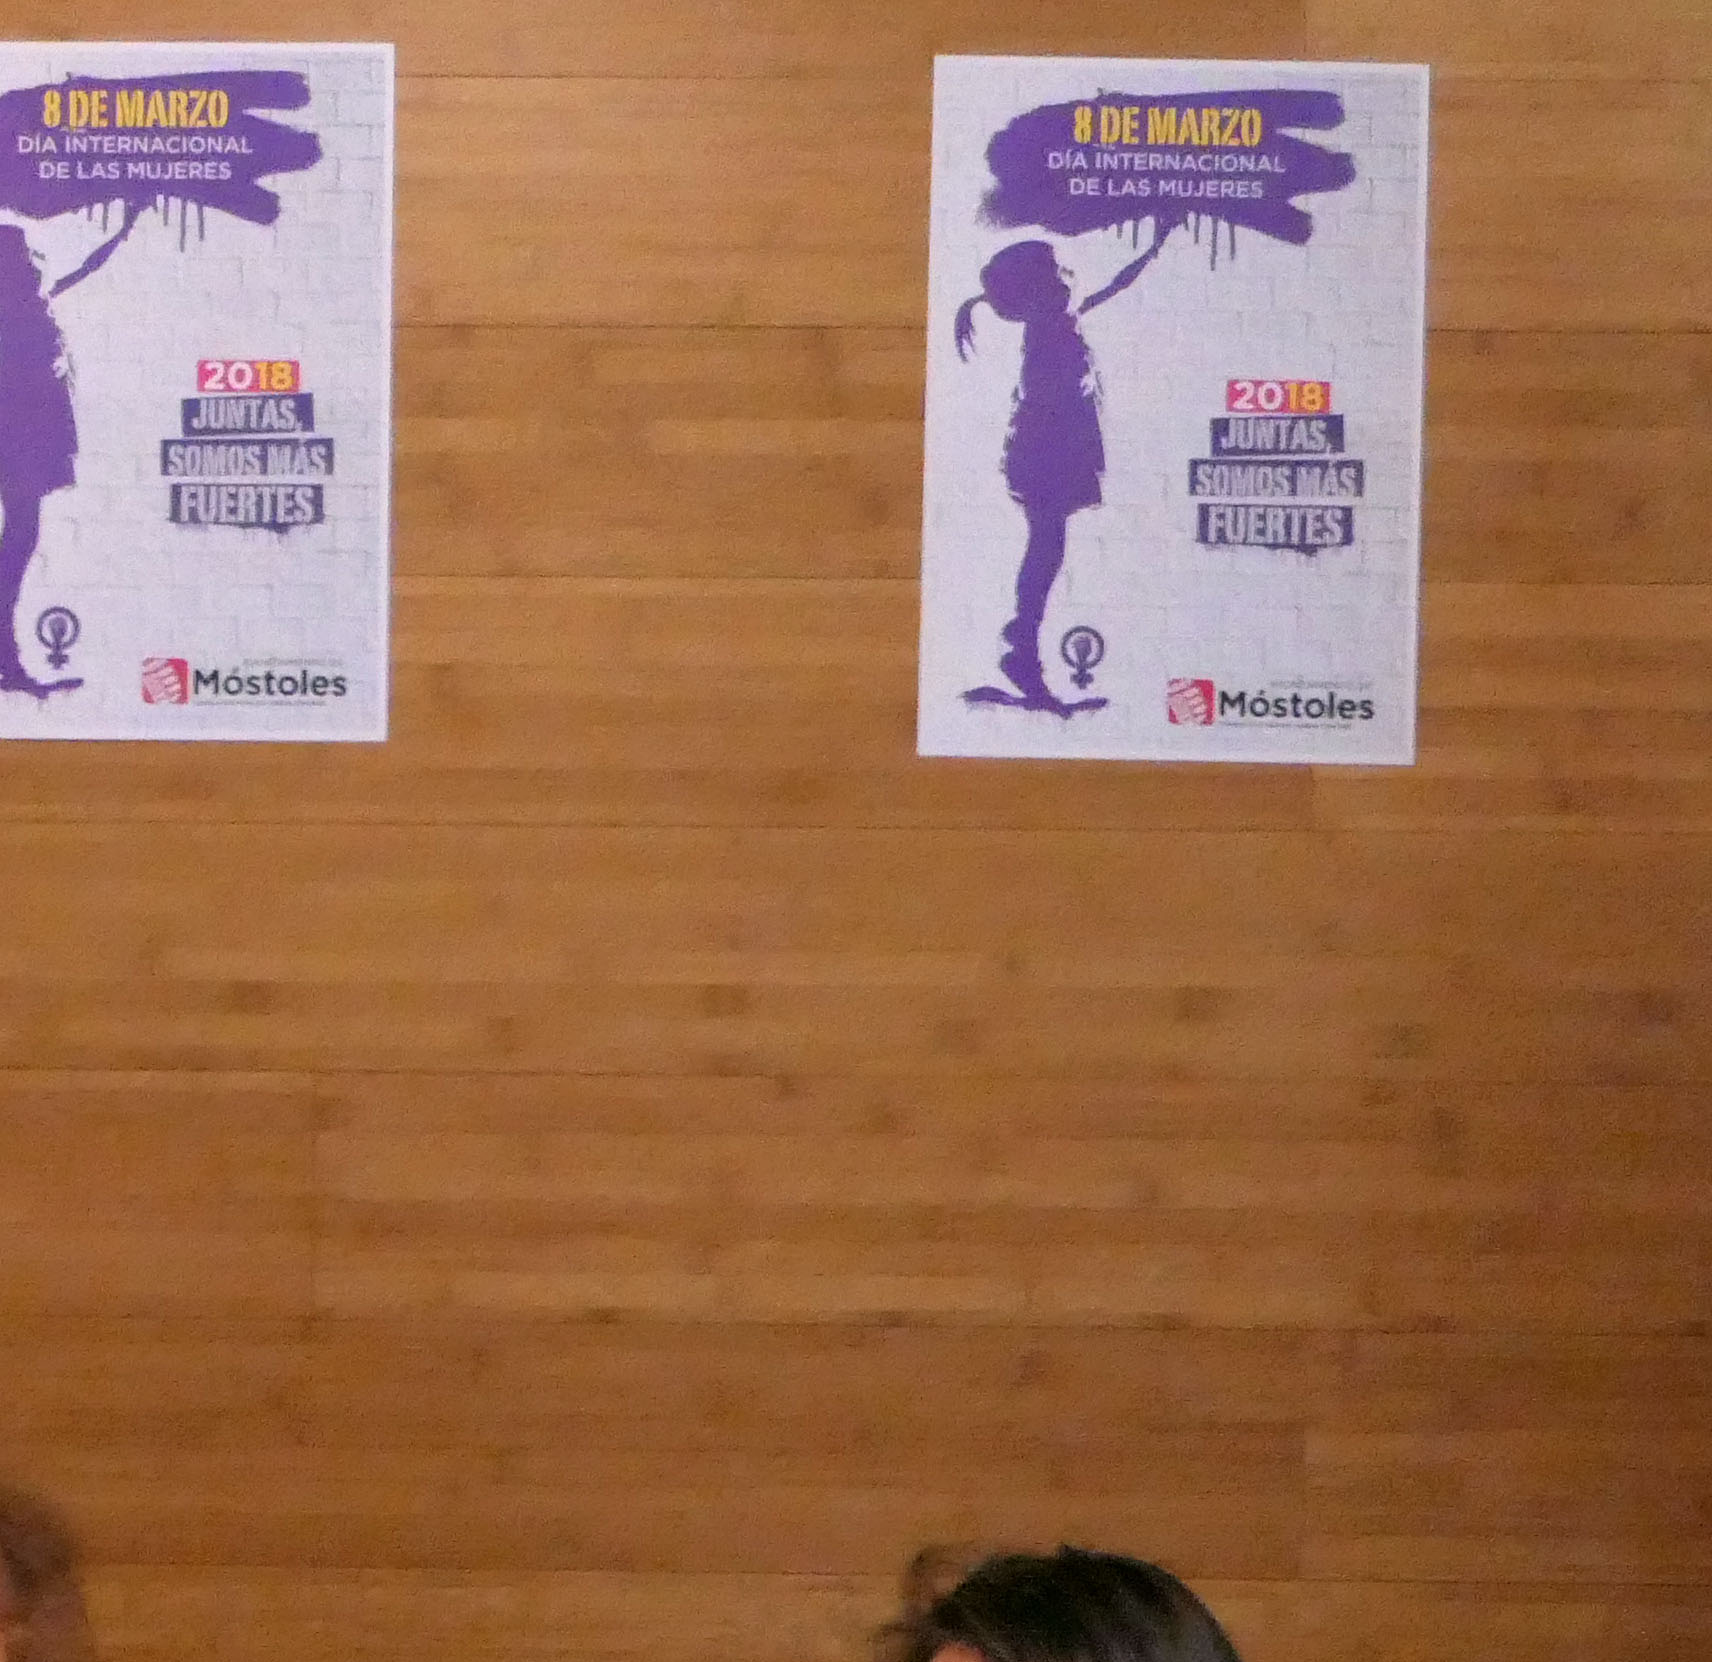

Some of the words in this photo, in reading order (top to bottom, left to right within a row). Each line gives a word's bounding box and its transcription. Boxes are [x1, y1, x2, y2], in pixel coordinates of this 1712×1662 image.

[43, 90, 62, 128] 8
[69, 90, 108, 128] DE
[116, 89, 230, 128] MARZO
[1074, 106, 1093, 144] 8
[1100, 106, 1140, 144] DE
[1147, 106, 1263, 145] MARZO
[18, 132, 57, 153] DÍA
[65, 135, 253, 154] INTERNACIONAL
[39, 161, 70, 180] DE
[76, 161, 120, 180] LAS
[127, 161, 232, 180] MUJERES
[1047, 149, 1088, 170] DÍA
[1095, 152, 1286, 173] INTERNACIONAL
[1069, 178, 1101, 196] DE
[1107, 178, 1151, 197] LAS
[1159, 179, 1264, 199] MUJERES
[203, 361, 293, 391] 2018
[1232, 381, 1325, 411] 2018
[192, 398, 303, 433] JUNTAS,
[1220, 417, 1332, 453] JUNTAS,
[167, 445, 261, 476] SOMOS
[1195, 463, 1292, 497] SOMOS
[179, 485, 314, 523] FUERTES
[1208, 505, 1345, 545] FUERTES
[193, 667, 347, 697] Móstoles
[1219, 689, 1375, 720] Móstoles
